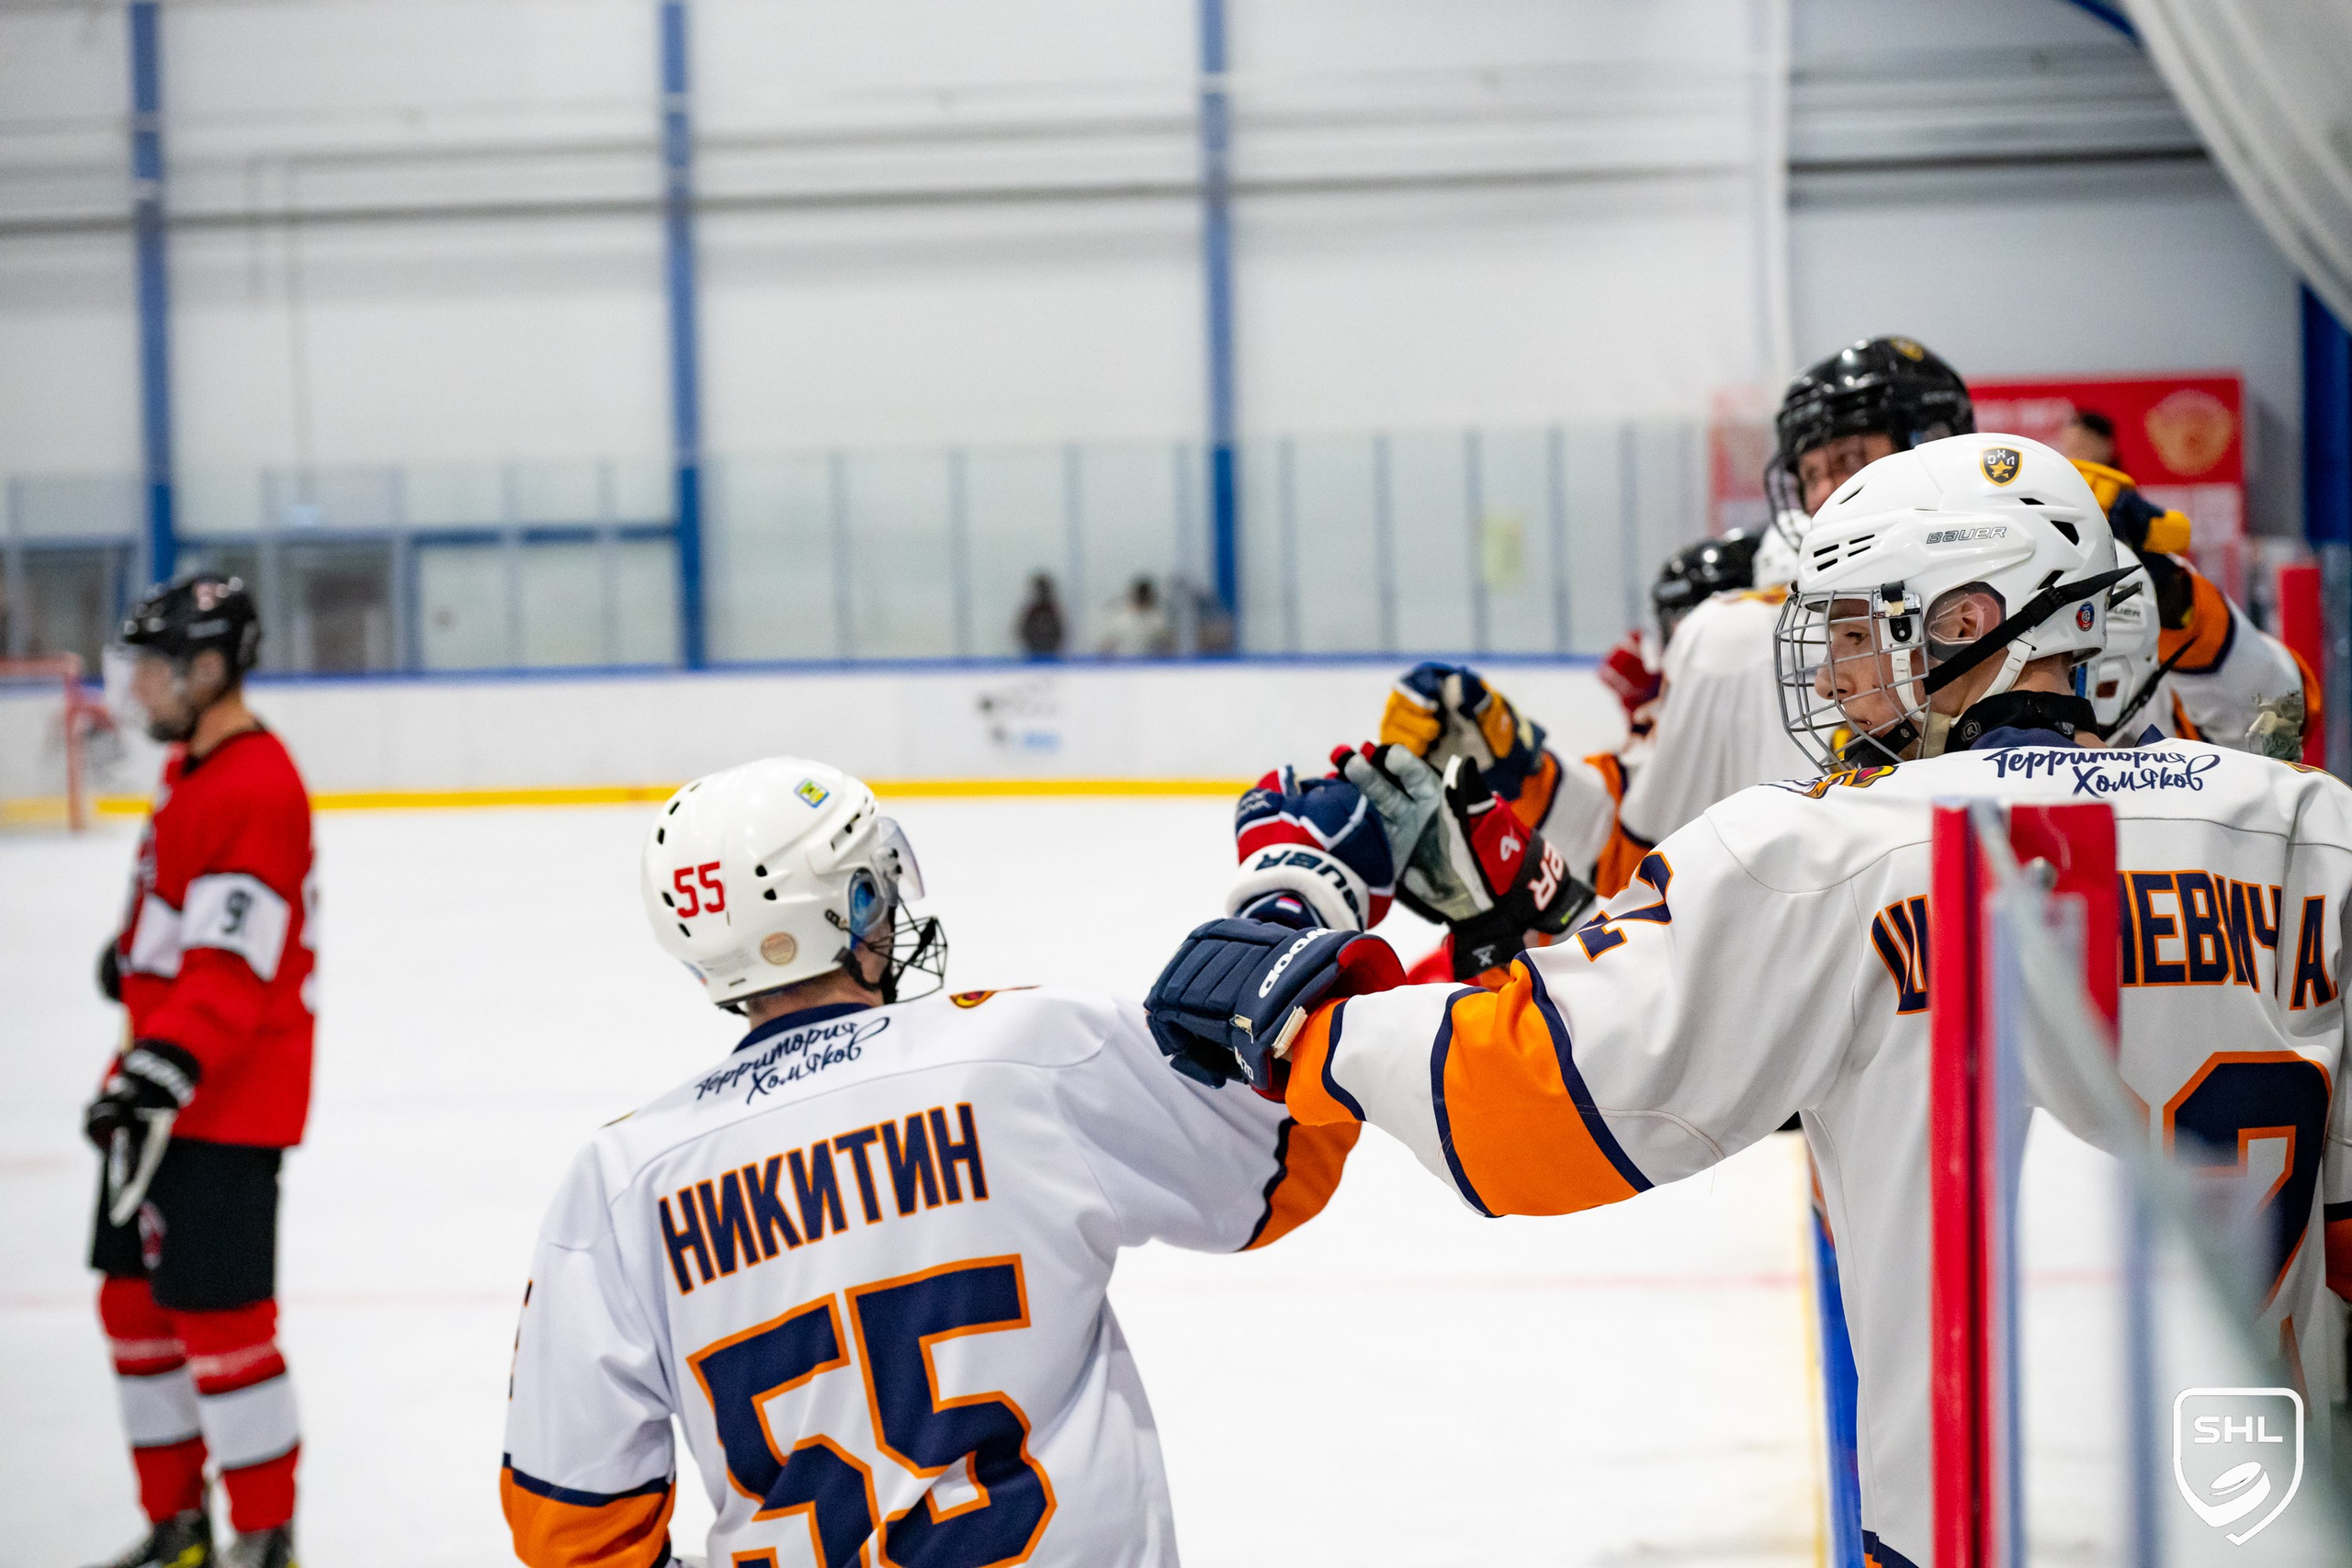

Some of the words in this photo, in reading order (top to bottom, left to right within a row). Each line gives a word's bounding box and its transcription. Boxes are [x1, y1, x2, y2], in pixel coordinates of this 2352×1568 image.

[1983, 748, 2188, 778] Территория
[2073, 754, 2222, 798] Хомяков
[673, 861, 726, 919] 55
[695, 1021, 859, 1100] Территория
[658, 1102, 989, 1295] НИКИТИН
[686, 1253, 1057, 1568] 55
